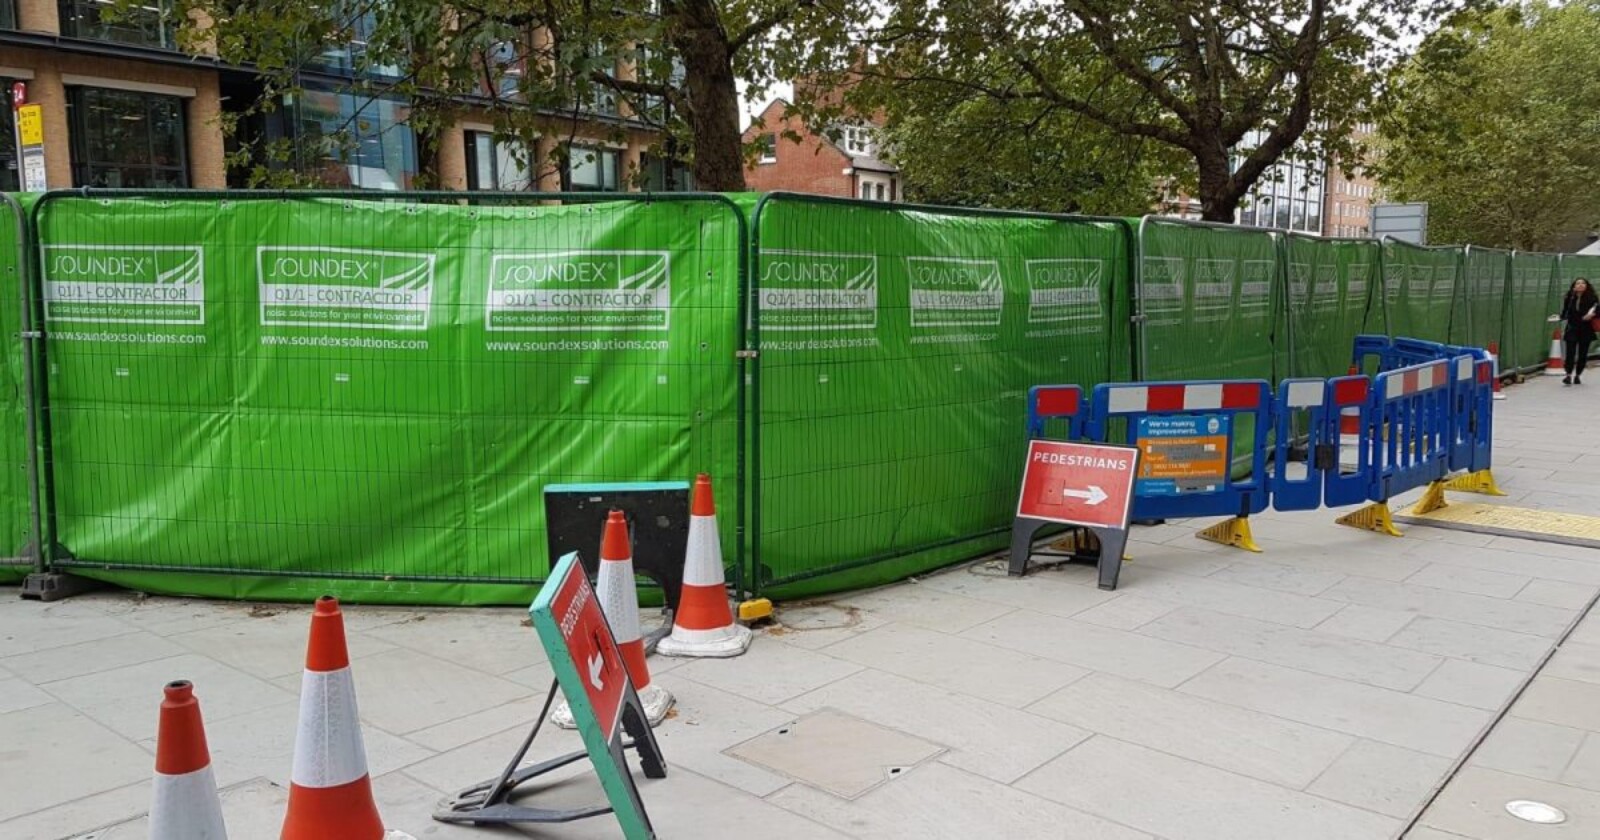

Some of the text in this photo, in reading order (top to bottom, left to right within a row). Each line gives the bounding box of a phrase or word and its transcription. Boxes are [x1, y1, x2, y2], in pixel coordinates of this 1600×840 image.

[58, 286, 83, 299] Q1/1
[96, 286, 188, 300] CONTRACTOR
[274, 288, 304, 301] Q1/1
[316, 288, 413, 305] CONTRACTOR
[551, 293, 653, 306] CONTRACTOR
[108, 305, 122, 315] for
[123, 308, 143, 317] your
[329, 310, 341, 319] for
[343, 312, 361, 320] your
[520, 314, 564, 323] solutions
[566, 314, 579, 322] for
[583, 315, 605, 324] your
[606, 313, 663, 322] environment
[260, 334, 429, 349] www.soundexsolutions.com
[486, 338, 669, 351] www.soundexsolutions.com
[1033, 451, 1128, 471] PEDESTRIANS
